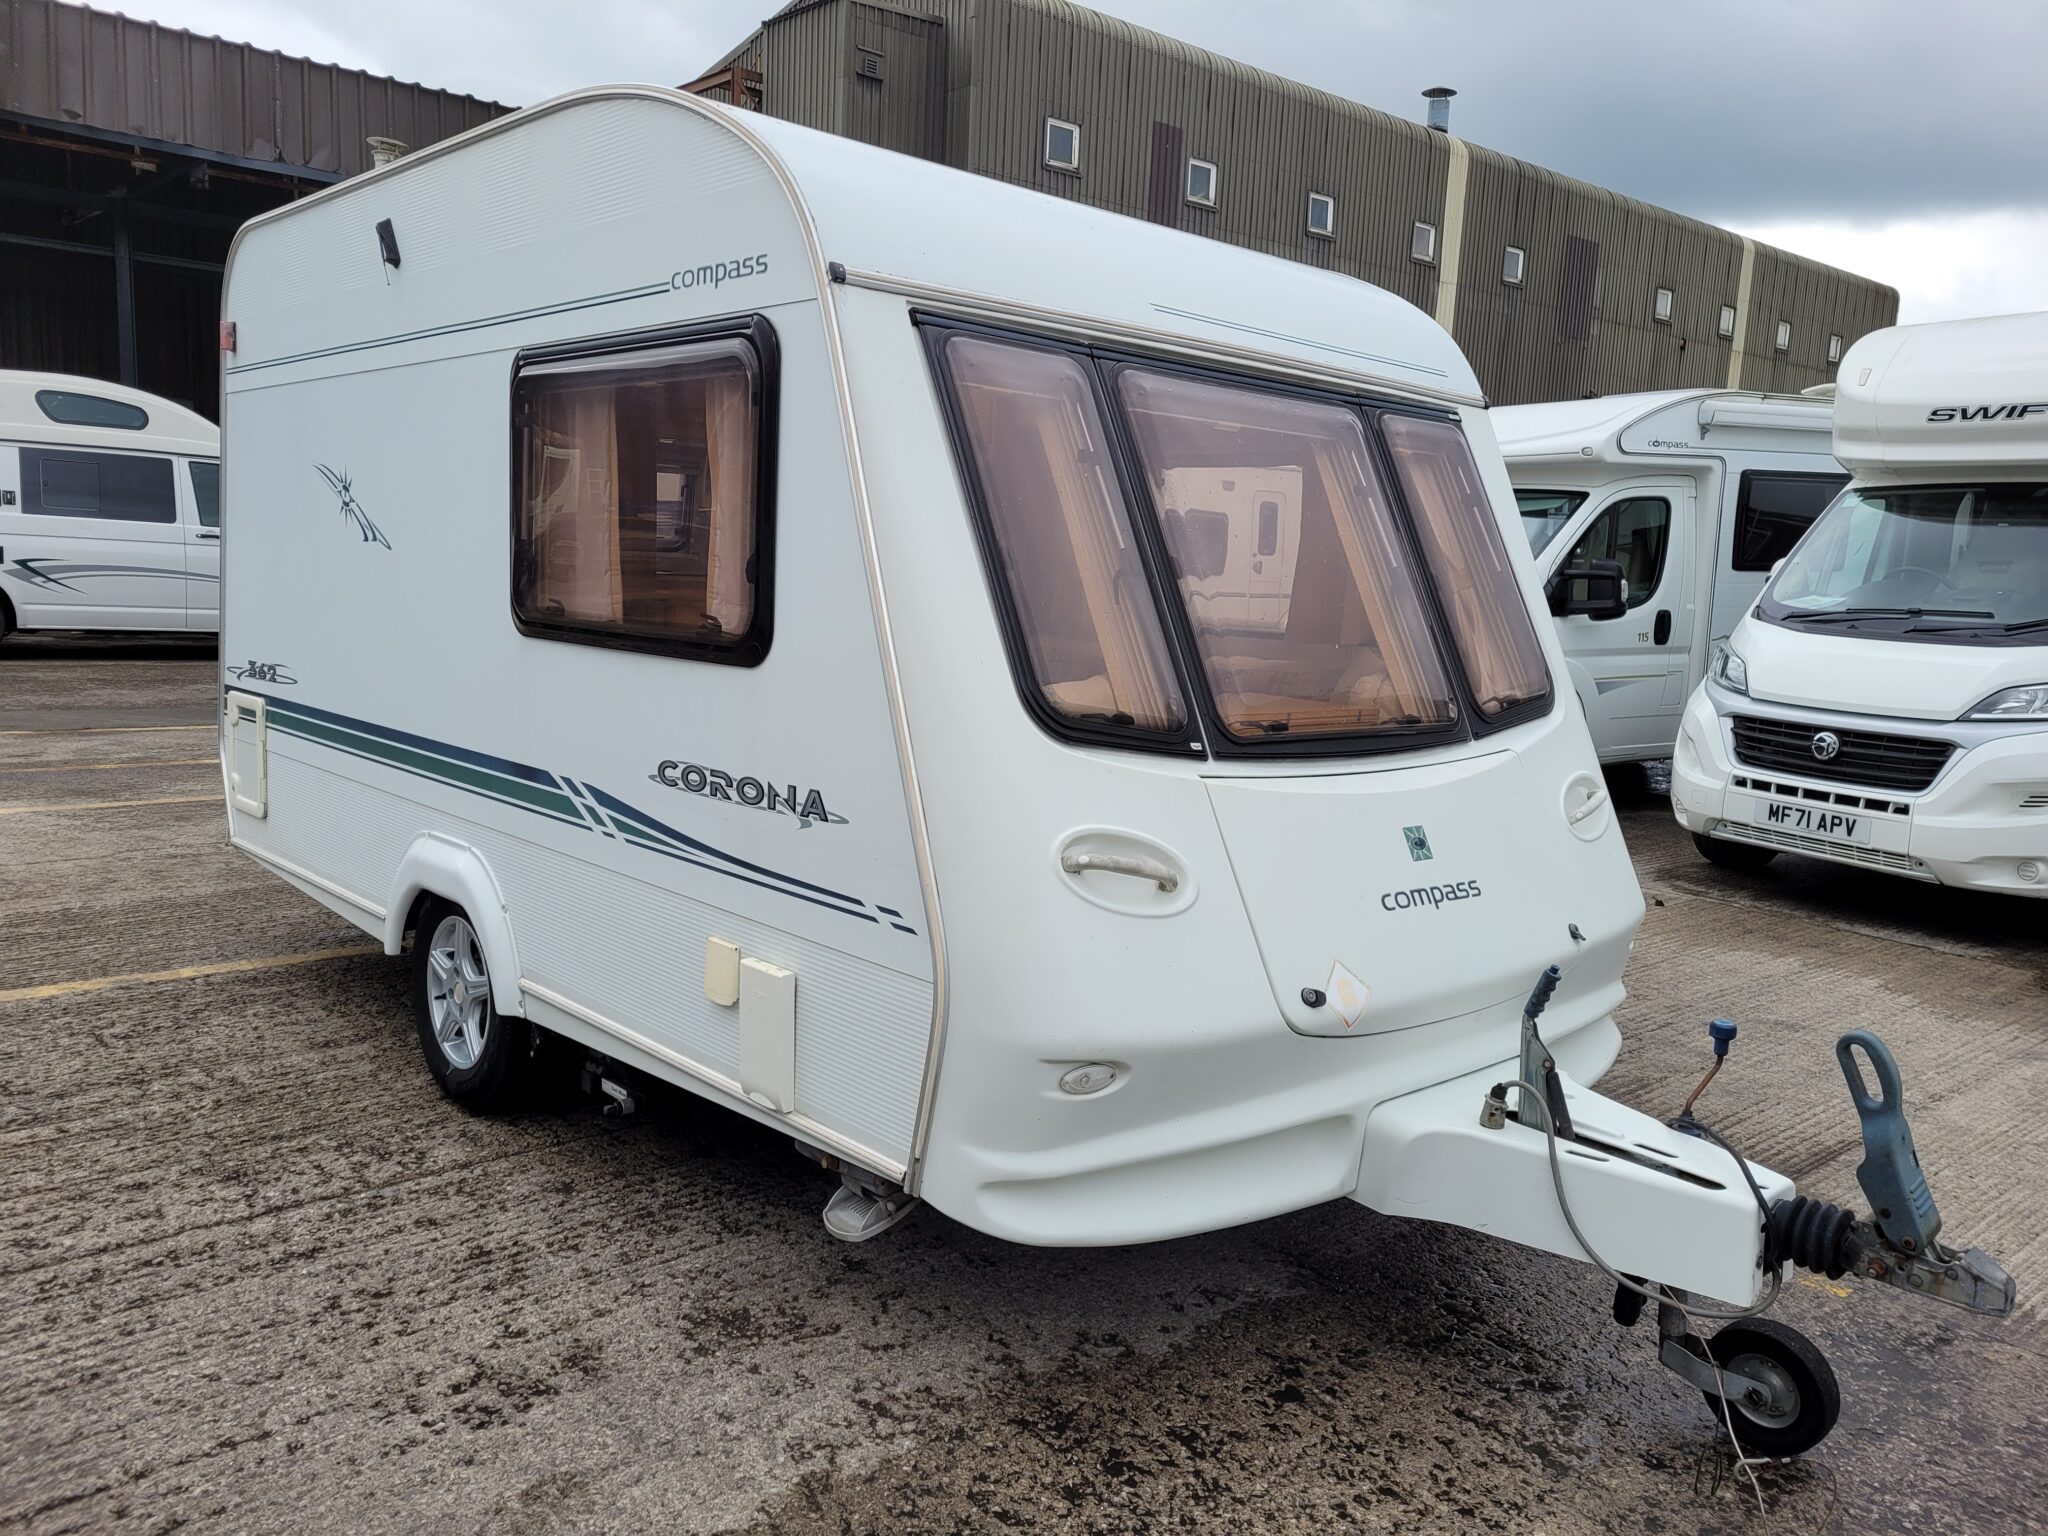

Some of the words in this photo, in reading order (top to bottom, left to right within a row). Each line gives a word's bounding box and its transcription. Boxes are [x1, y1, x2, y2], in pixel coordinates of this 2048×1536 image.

[671, 253, 768, 290] compass
[1647, 437, 1689, 450] compass
[248, 659, 277, 683] 362
[657, 759, 830, 823] CORONA
[1767, 802, 1812, 829] MF71
[1816, 812, 1857, 837] APV
[1380, 879, 1482, 911] compass
